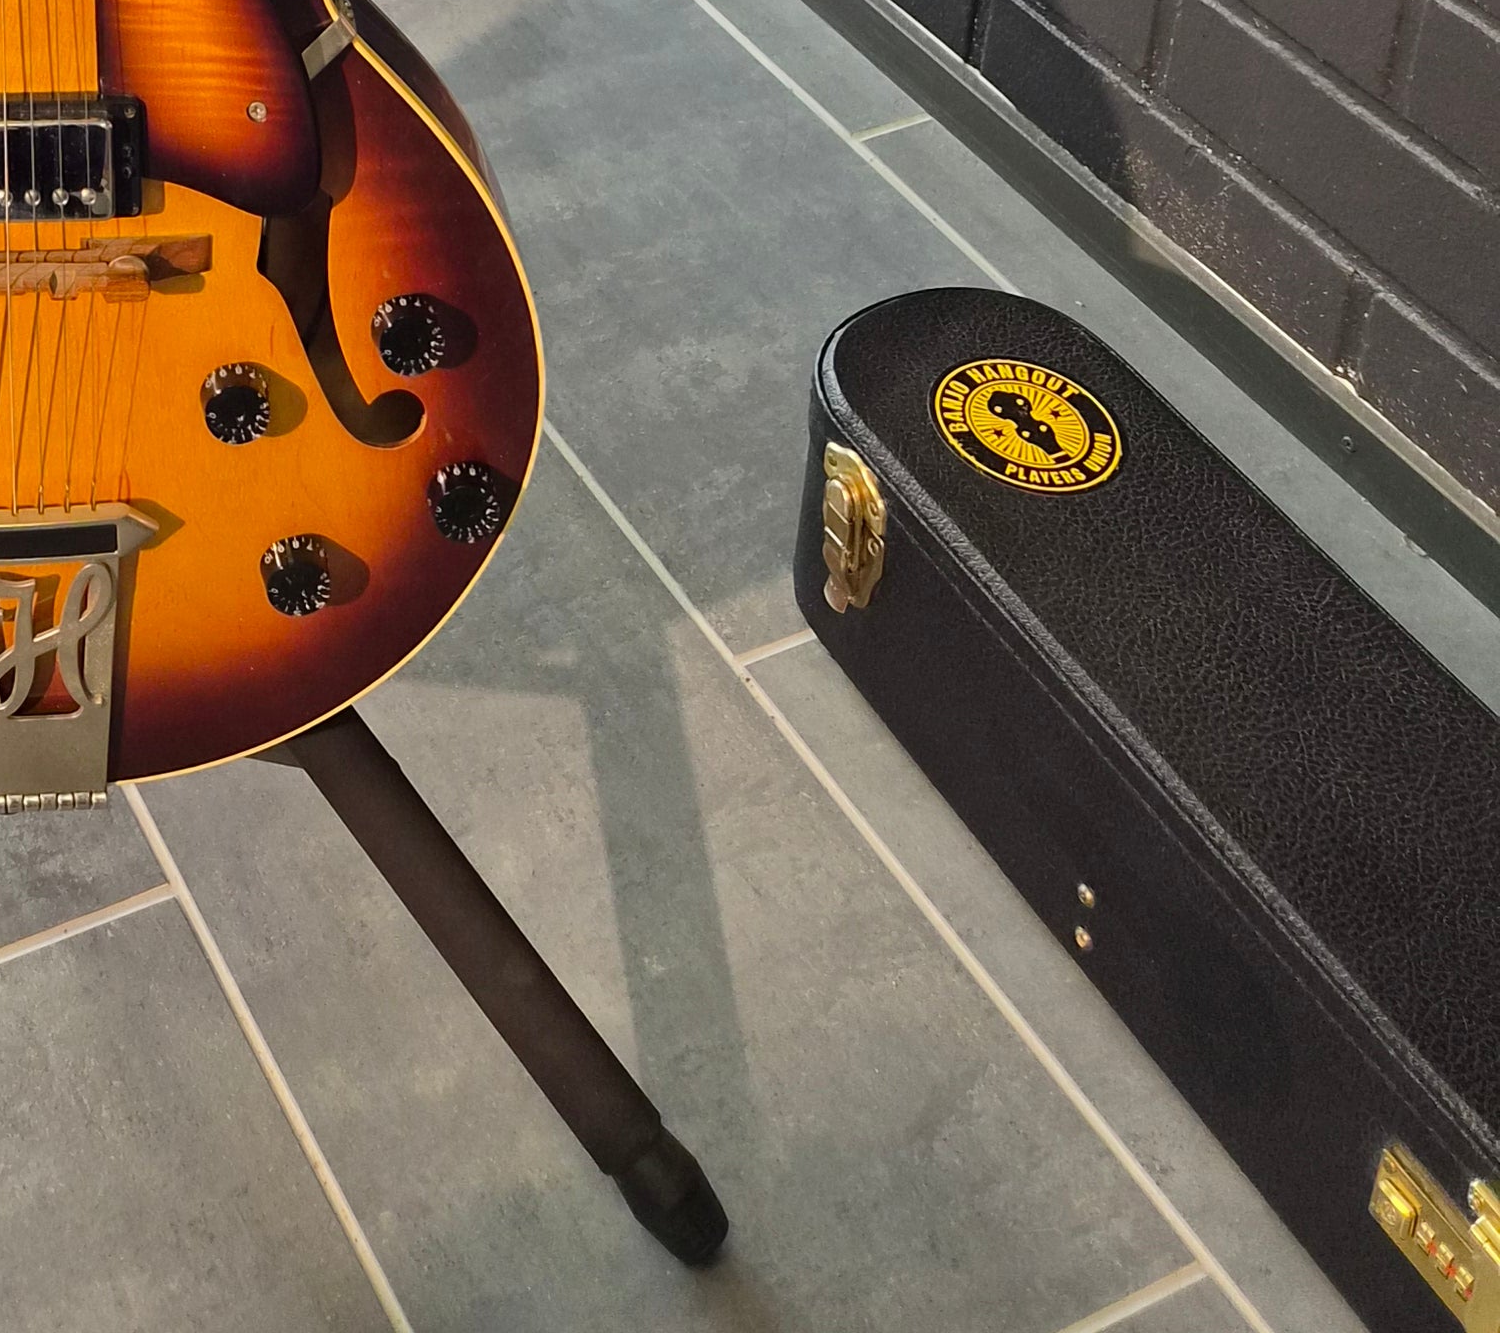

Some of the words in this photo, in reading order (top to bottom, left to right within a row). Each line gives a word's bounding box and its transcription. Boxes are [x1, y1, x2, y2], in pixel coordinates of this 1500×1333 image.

[942, 380, 970, 433] BANJO
[966, 364, 1080, 398] HANGOUT
[1005, 463, 1087, 484] PLAYERS
[1083, 432, 1113, 472] UNION
